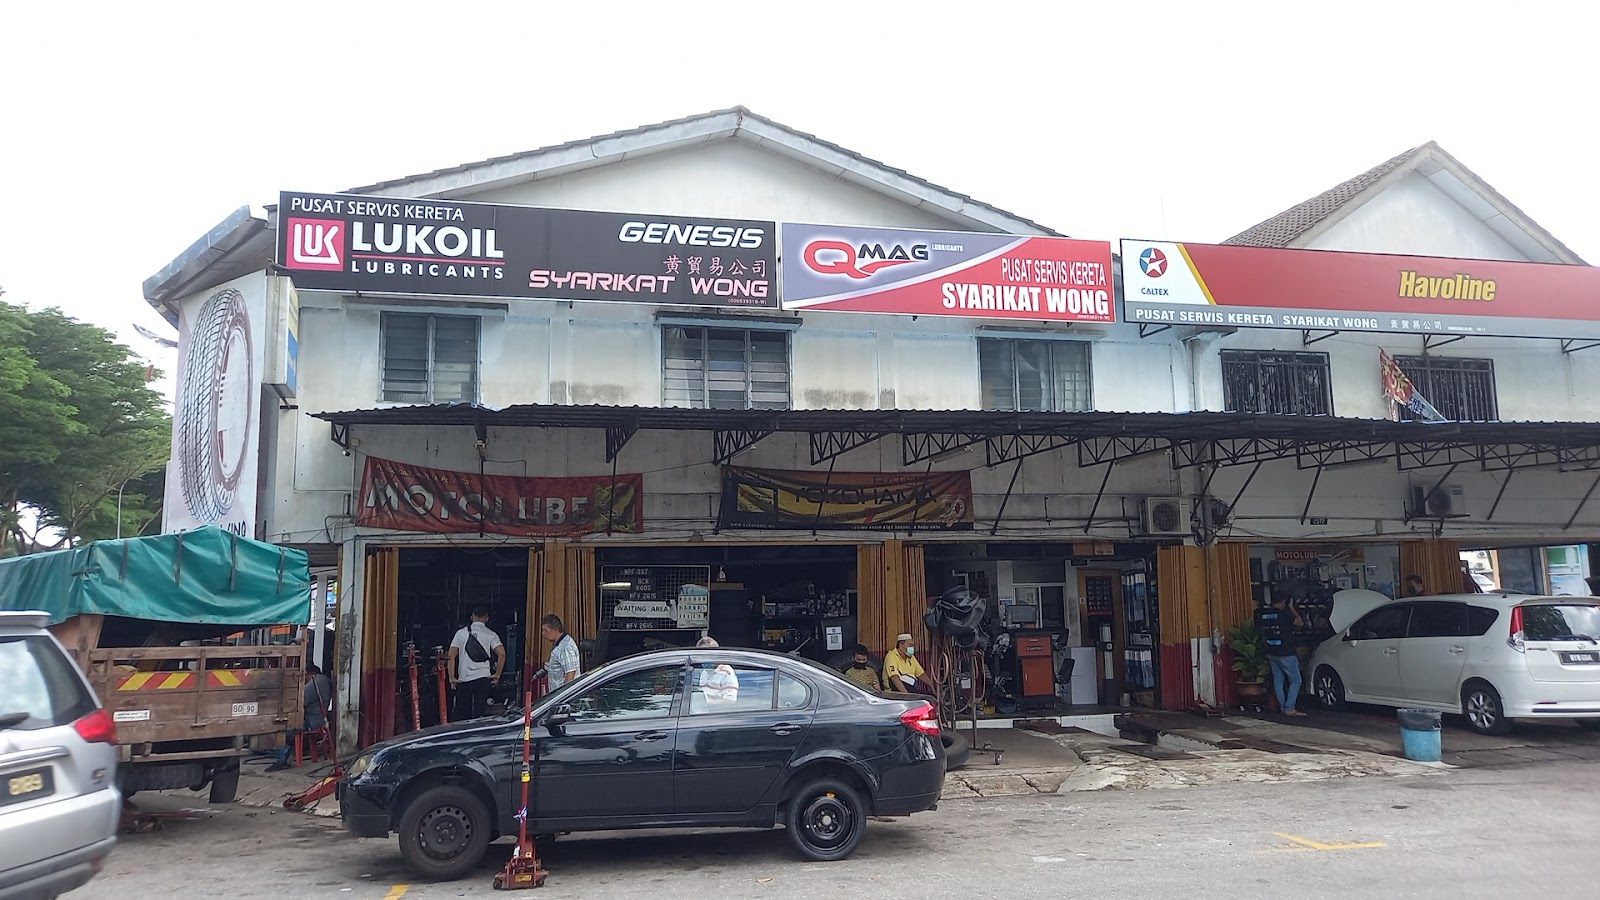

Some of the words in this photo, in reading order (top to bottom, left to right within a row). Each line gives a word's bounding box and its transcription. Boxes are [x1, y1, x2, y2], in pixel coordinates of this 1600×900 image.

[291, 197, 345, 214] PUSAT
[347, 200, 401, 218] SERVIS
[404, 204, 465, 222] KERETA
[352, 221, 504, 259] LUKOIL
[618, 221, 765, 249] GENESIS
[351, 260, 504, 280] LUBRICANTS
[528, 269, 676, 294] SYARIKAT
[690, 277, 769, 298] WONG
[1001, 257, 1032, 282] PUSAT
[1034, 259, 1067, 285] SERVIS
[1069, 261, 1107, 287] KERETA
[942, 282, 1042, 312] SYARIKAT
[1046, 286, 1109, 315] WONG
[1140, 286, 1169, 297] CALTEX
[1398, 270, 1497, 302] Havoline
[1136, 307, 1176, 322] PUSAT
[1179, 310, 1224, 323] SERVIS
[1227, 312, 1274, 325] KERETA
[1282, 314, 1340, 328] SYARIKAT
[1343, 316, 1378, 330] WONG
[366, 477, 589, 526] MOTOLUBE
[233, 704, 243, 713] 80
[246, 705, 255, 713] 90
